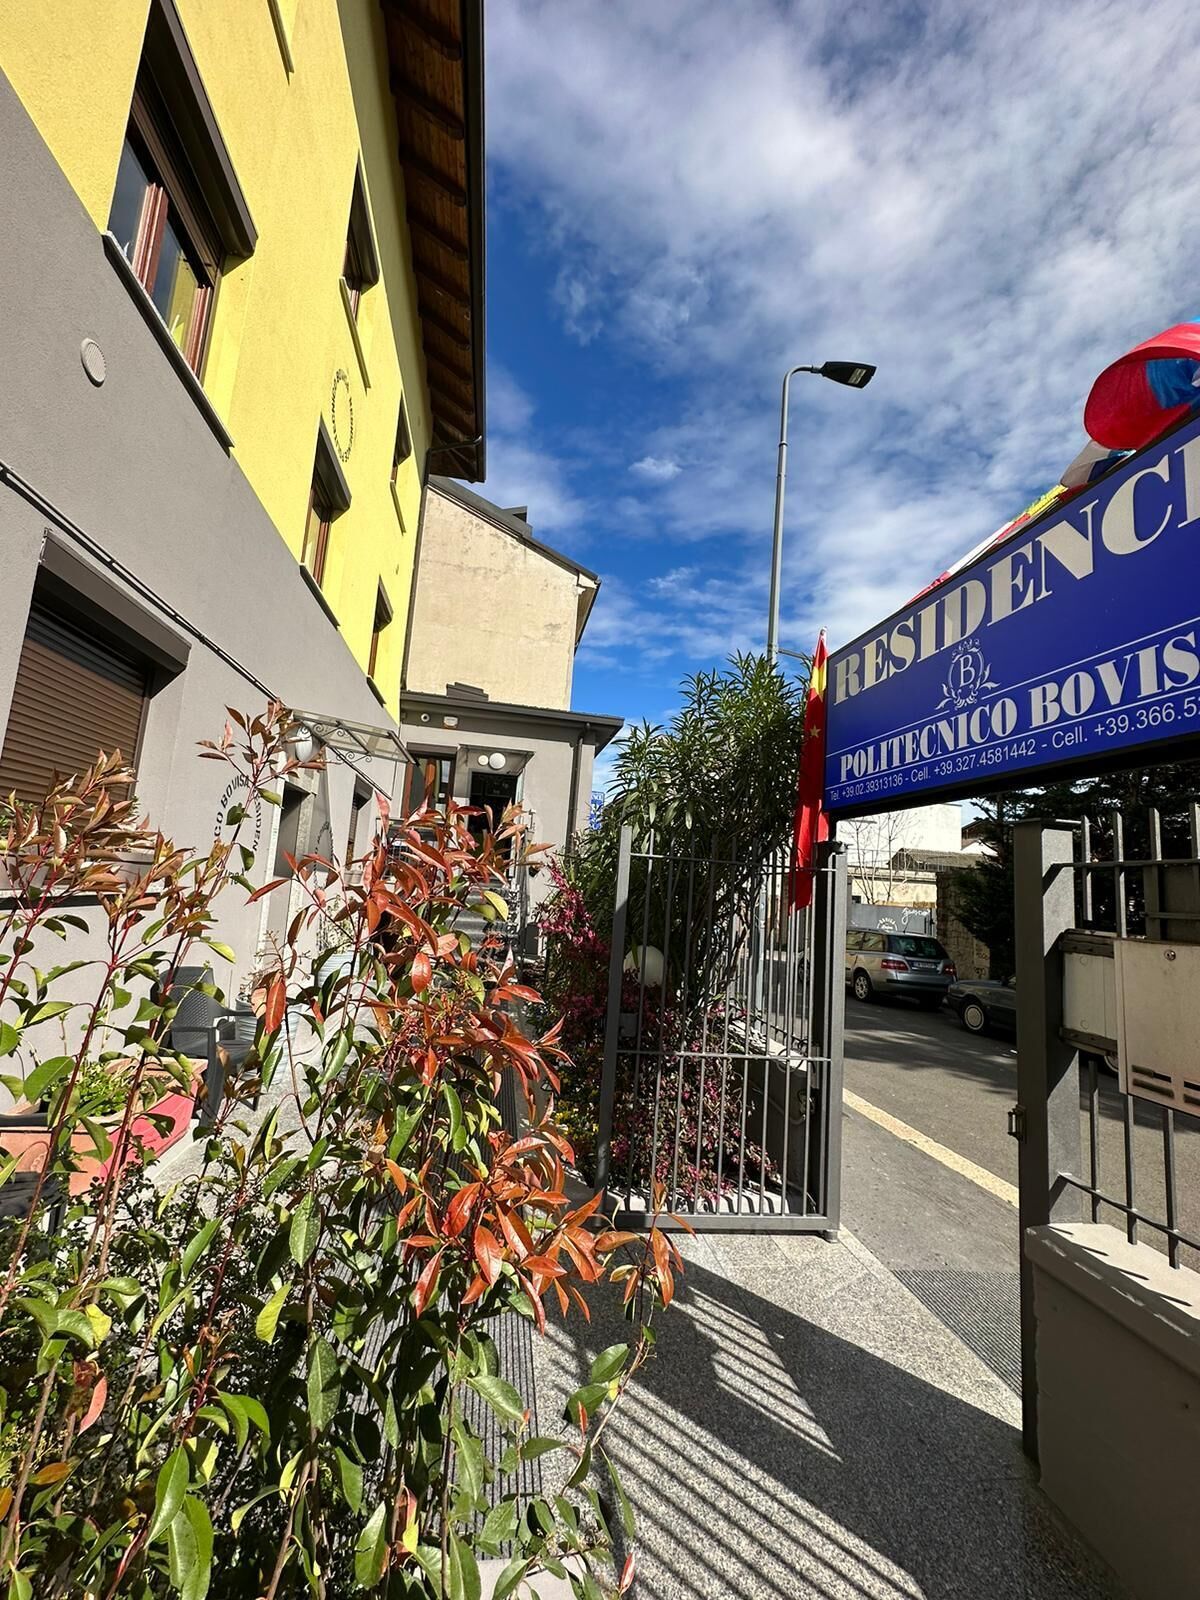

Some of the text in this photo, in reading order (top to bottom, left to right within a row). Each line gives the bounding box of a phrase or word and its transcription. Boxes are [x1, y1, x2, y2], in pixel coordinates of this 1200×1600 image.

[839, 697, 1018, 783] POLITECNICO
[911, 766, 931, 783] Cell.
[934, 738, 1036, 776] +39.327.4581442
[1052, 725, 1089, 748] Cell.
